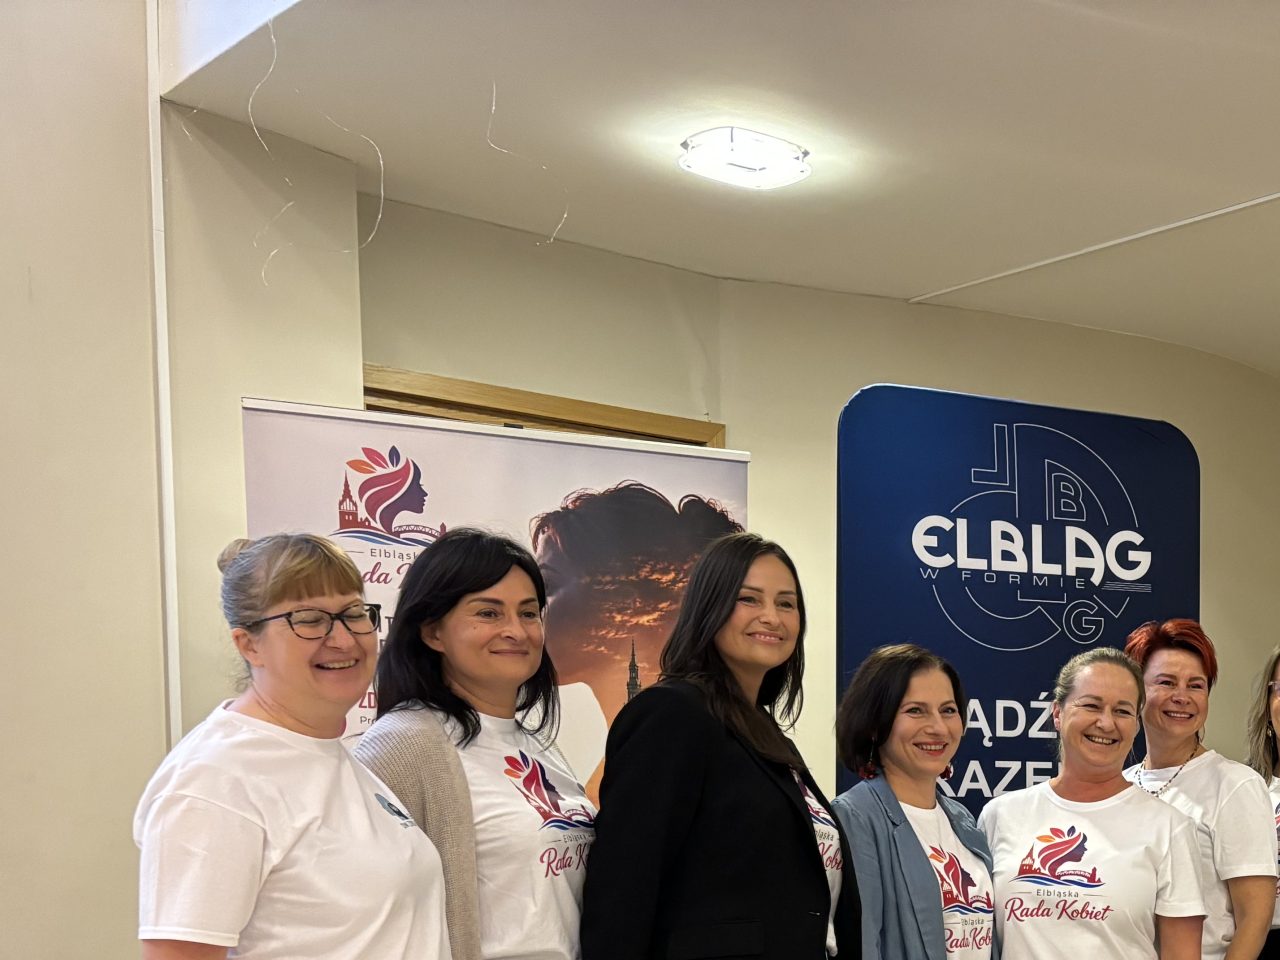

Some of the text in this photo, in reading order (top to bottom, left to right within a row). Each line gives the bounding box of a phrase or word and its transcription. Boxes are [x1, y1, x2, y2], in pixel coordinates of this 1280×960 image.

[370, 548, 418, 561] Elbląsk
[362, 561, 393, 585] da
[919, 567, 1086, 590] W FORMIE
[963, 691, 1058, 748] ĄDŹ
[1004, 896, 1114, 922] Rada Kobiet
